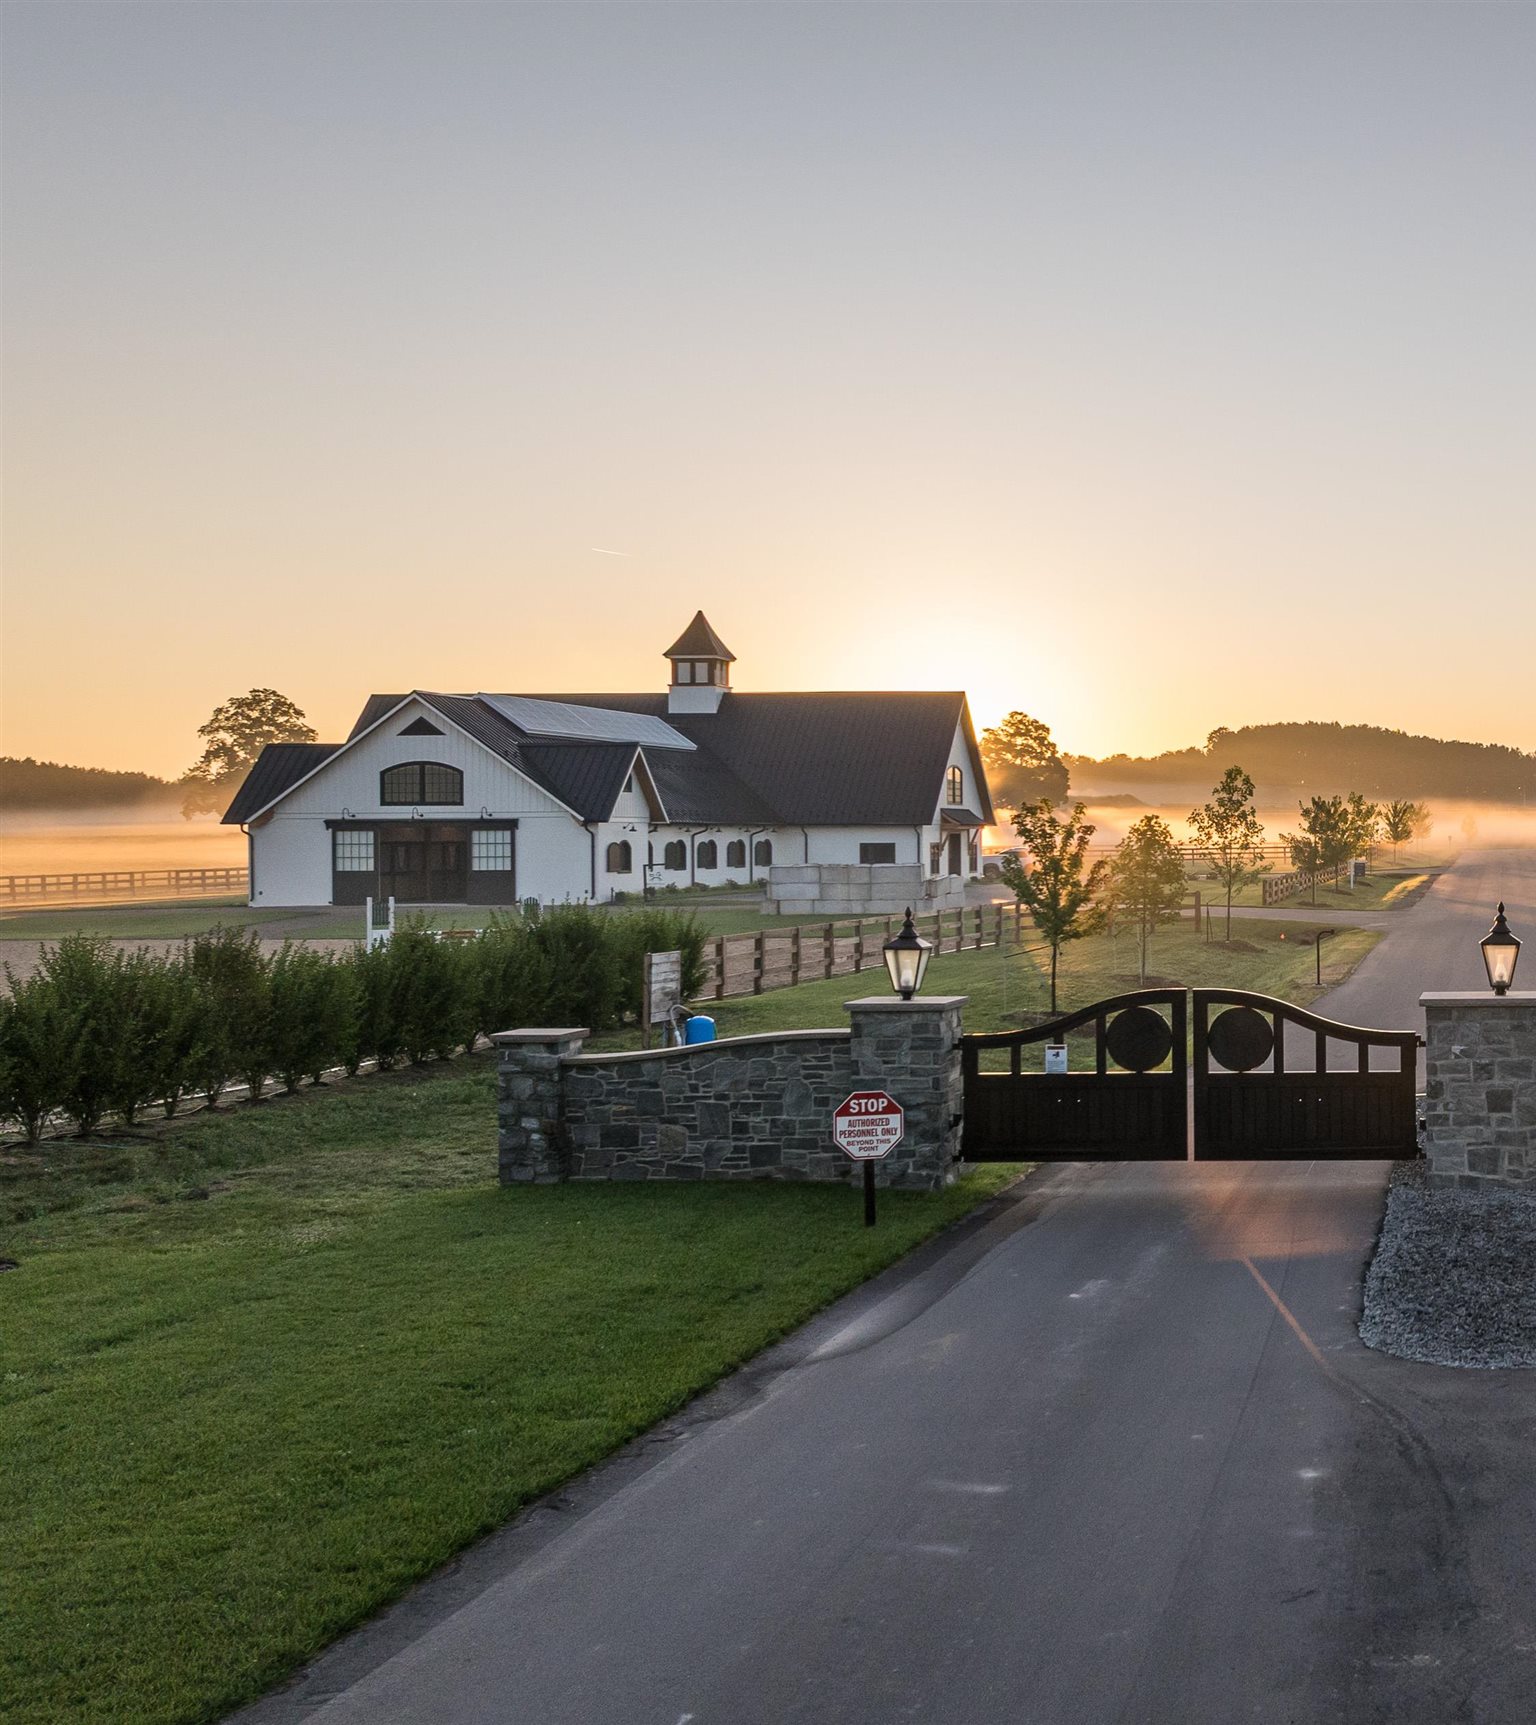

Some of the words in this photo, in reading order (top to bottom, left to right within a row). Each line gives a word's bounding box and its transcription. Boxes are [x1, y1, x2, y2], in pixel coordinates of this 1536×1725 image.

[849, 1098, 888, 1113] STOP
[847, 1117, 890, 1128] AUTHORIZED
[839, 1128, 879, 1139] PERSONNEL
[881, 1127, 898, 1136] ONLY
[846, 1139, 874, 1147] BEYOND
